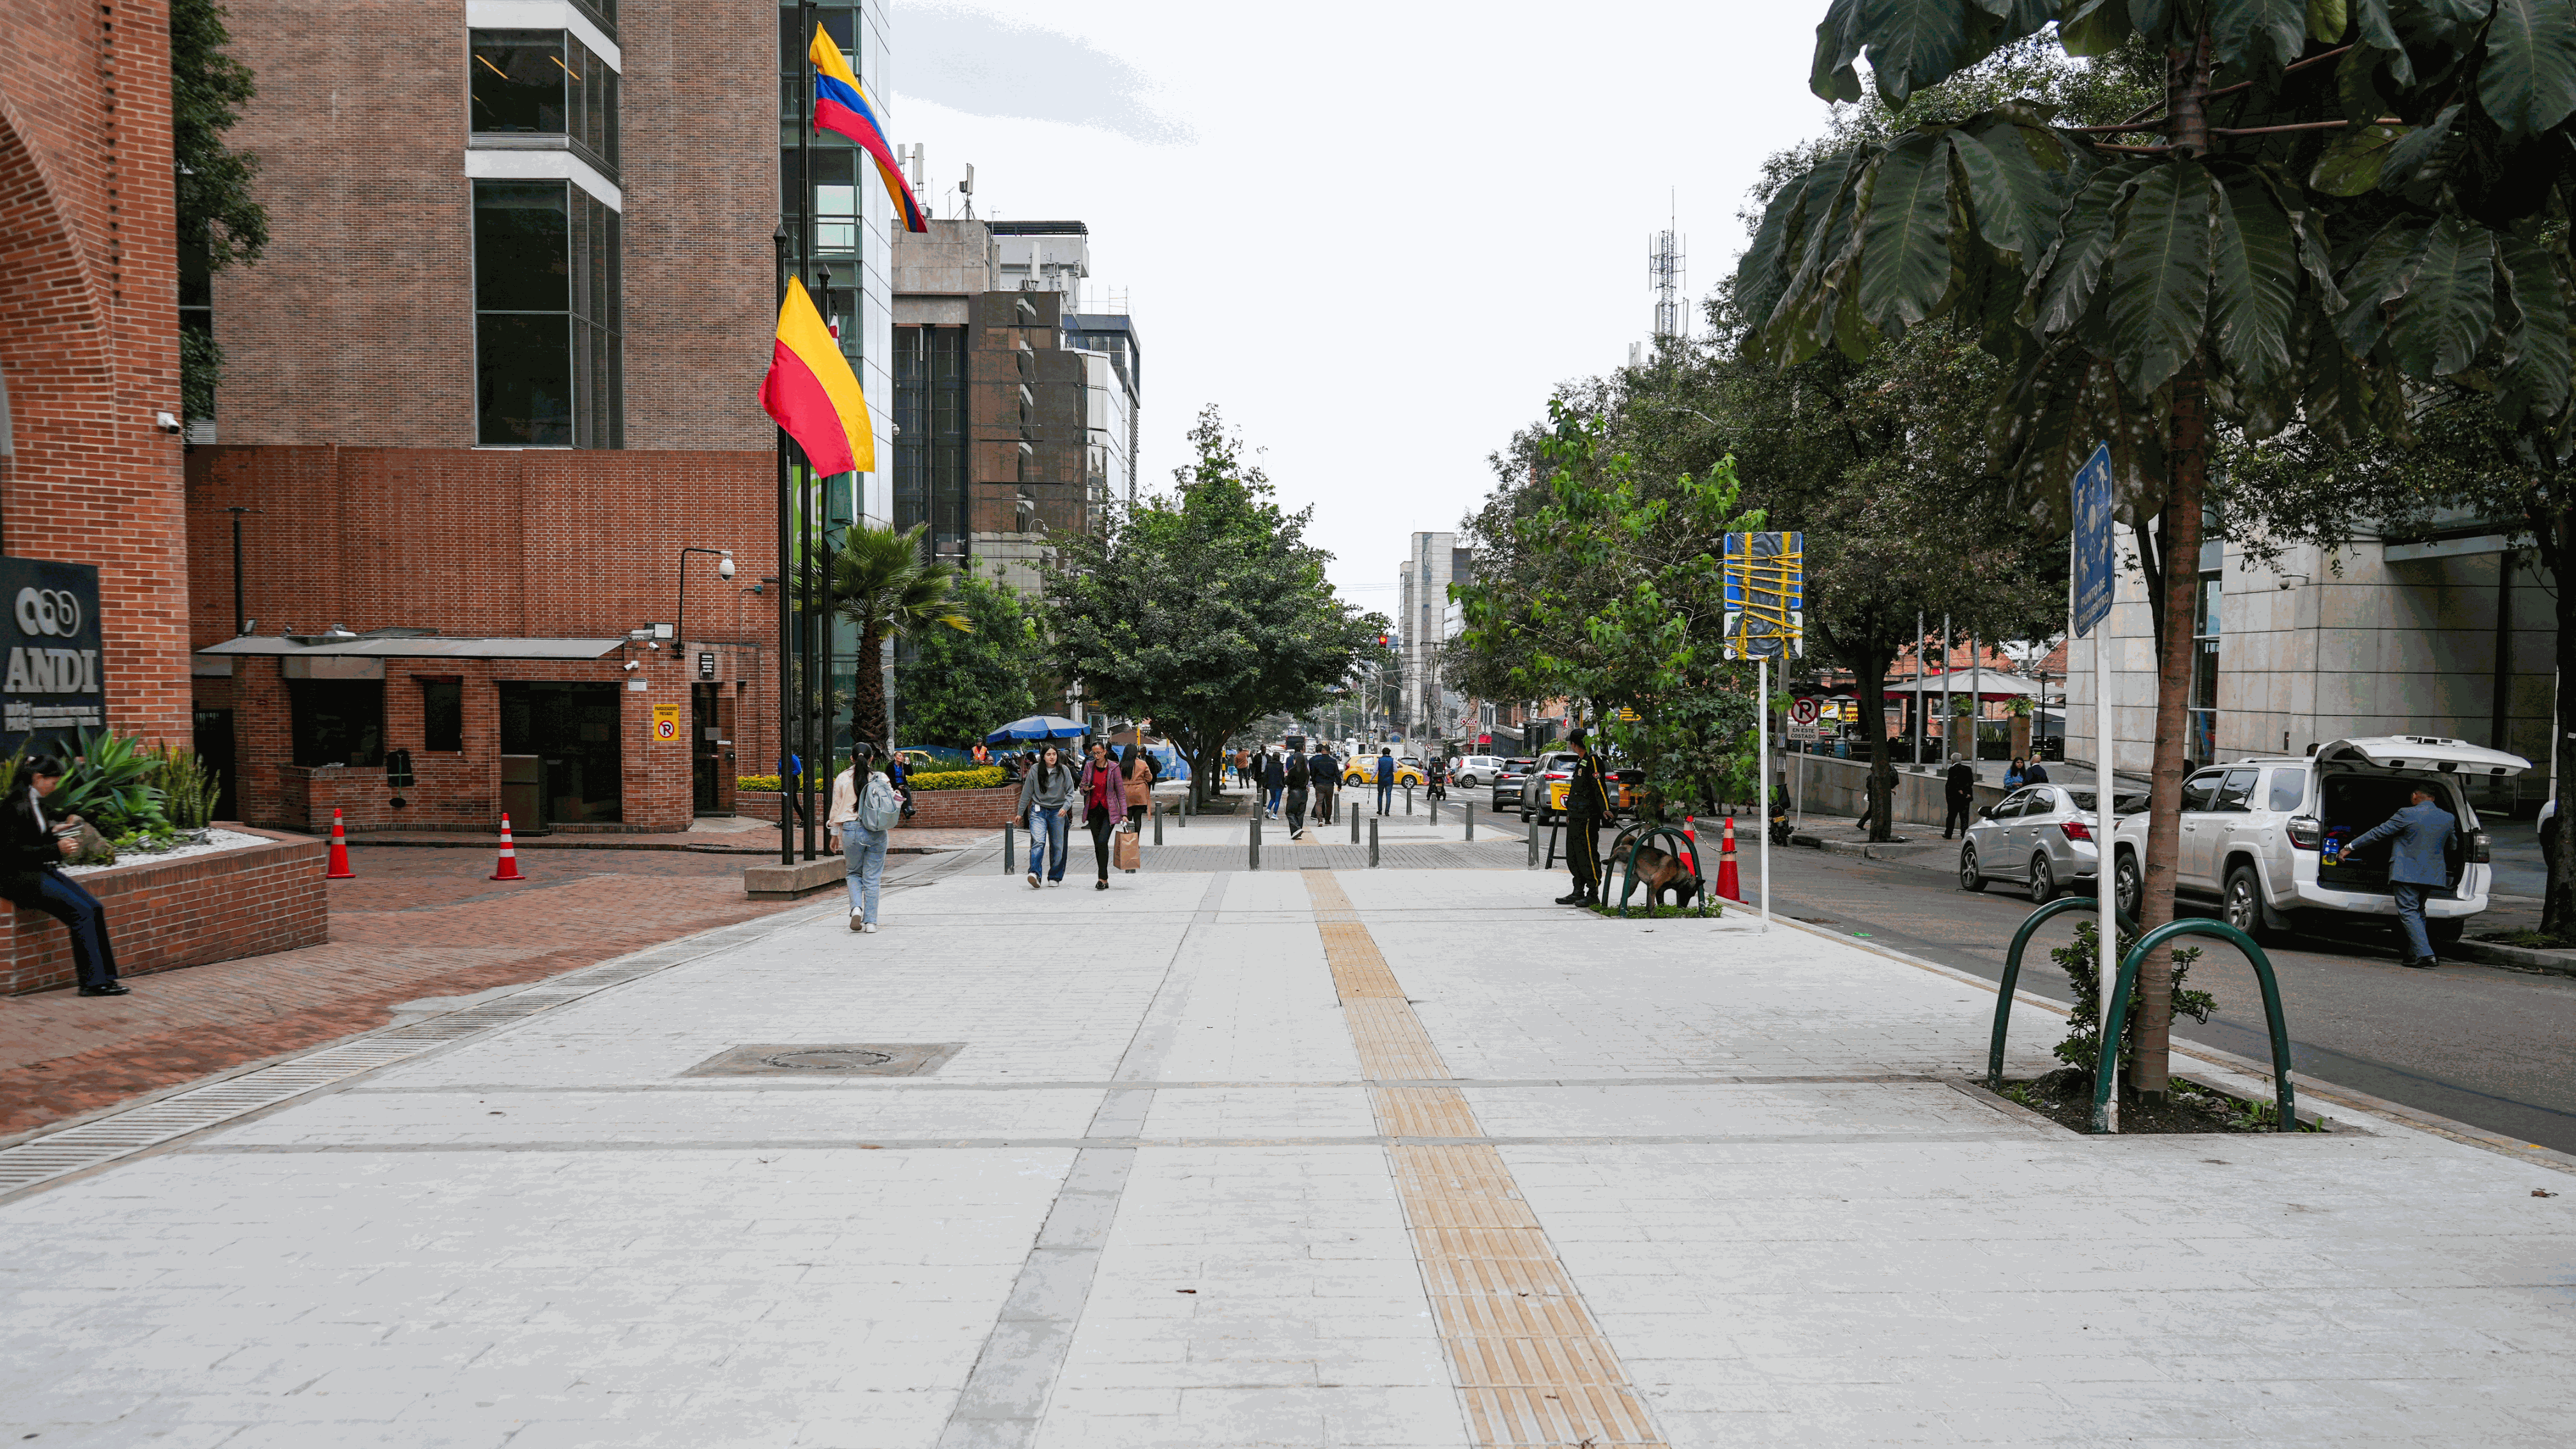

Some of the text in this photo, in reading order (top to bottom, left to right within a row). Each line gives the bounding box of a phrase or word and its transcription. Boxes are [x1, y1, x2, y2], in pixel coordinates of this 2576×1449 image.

[2079, 591, 2109, 627] ENCUENTRO
[2081, 576, 2106, 608] PUNTO DE
[3, 647, 99, 693] ANDI
